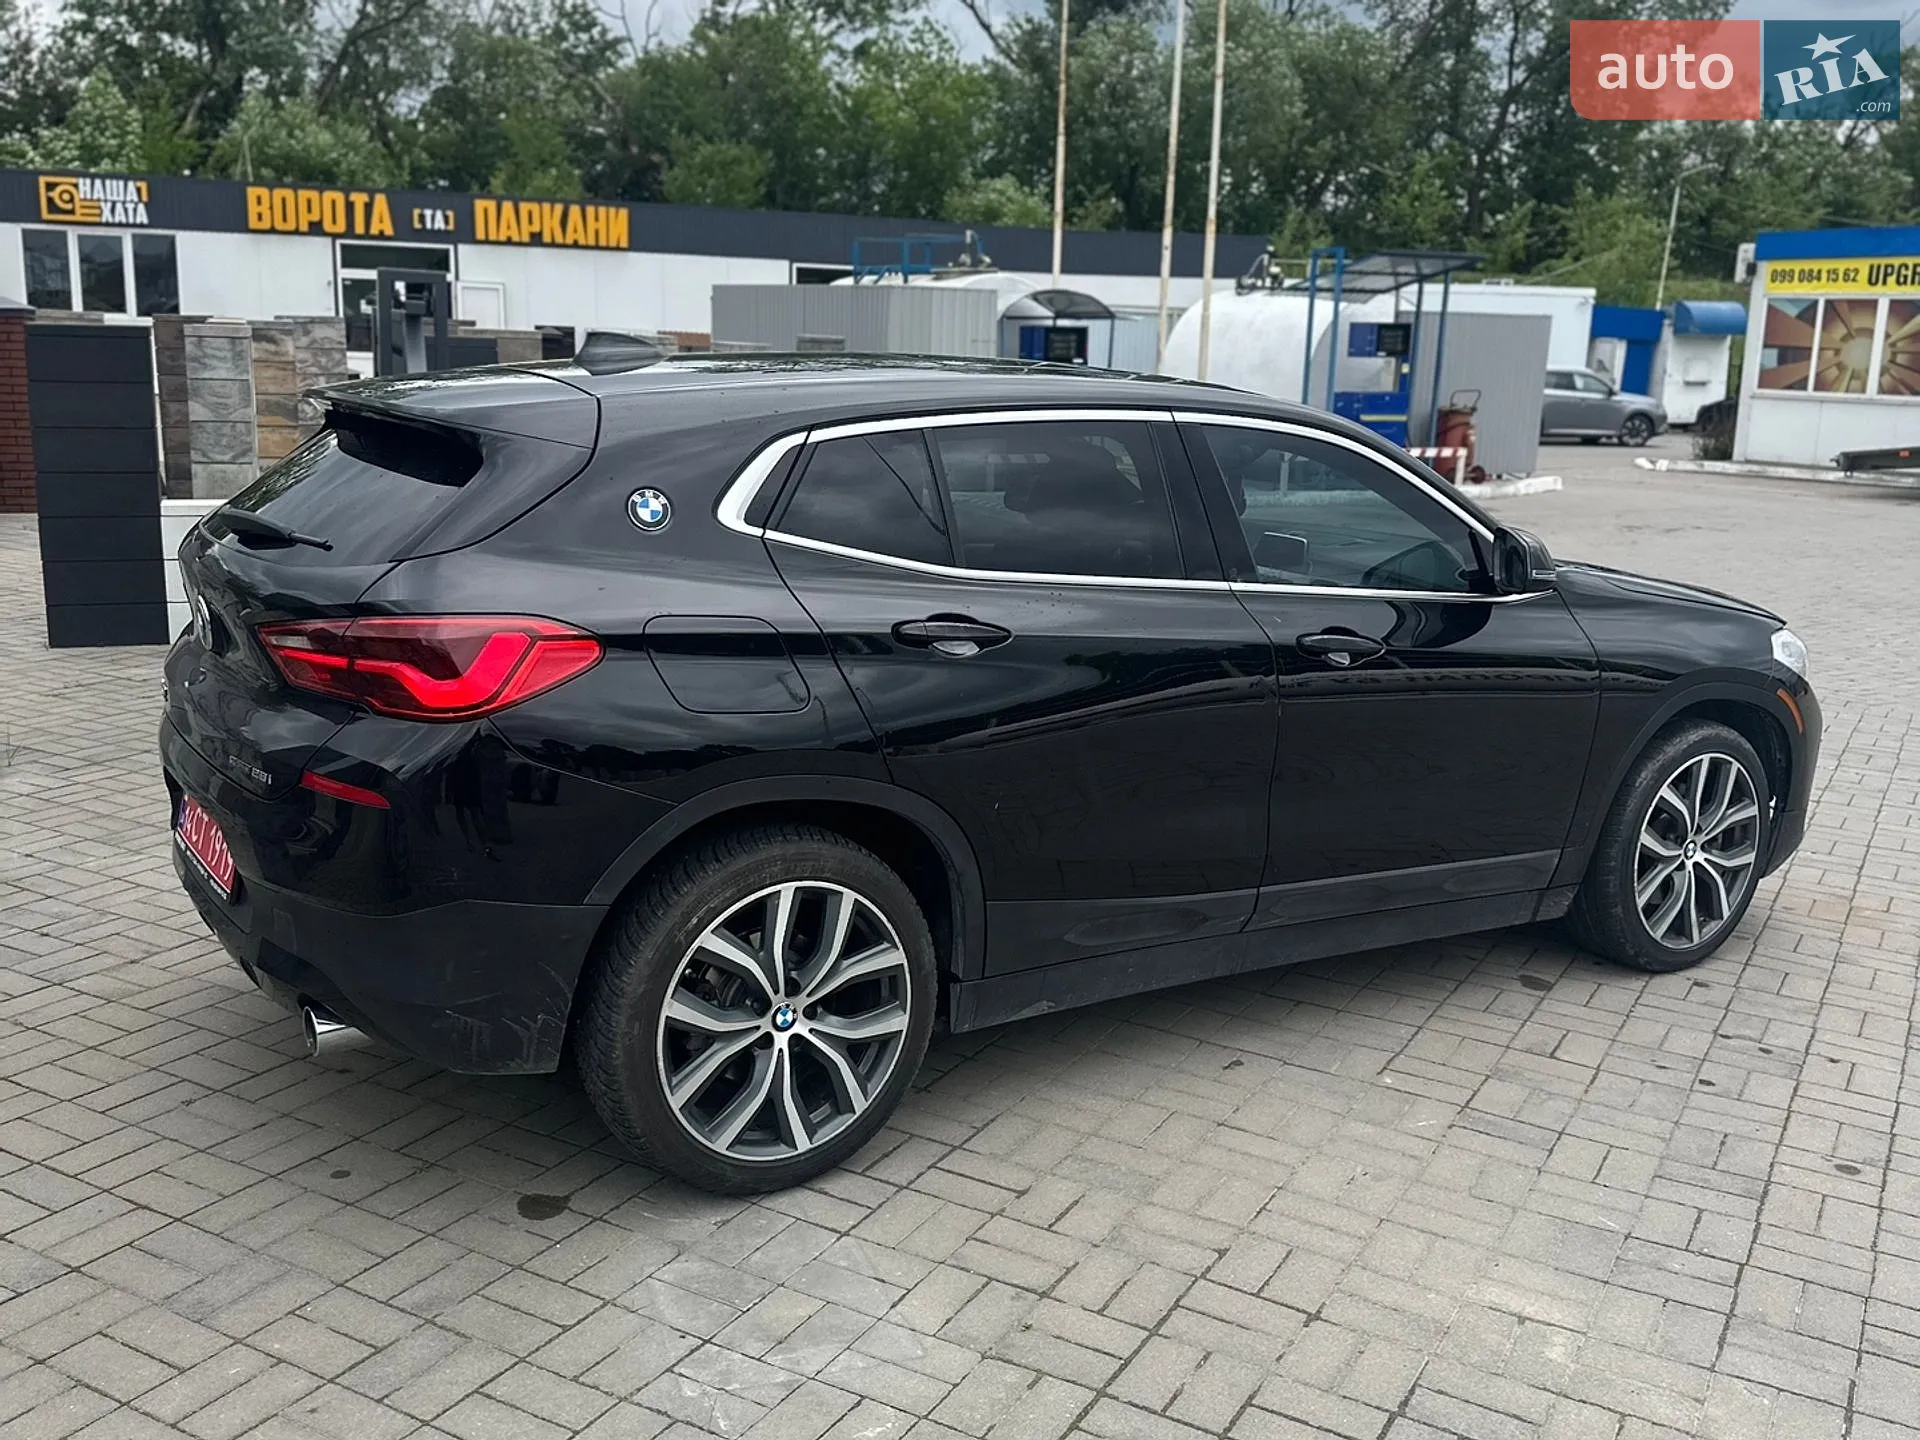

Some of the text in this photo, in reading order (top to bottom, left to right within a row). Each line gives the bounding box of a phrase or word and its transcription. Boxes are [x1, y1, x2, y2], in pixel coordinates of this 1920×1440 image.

[78, 177, 140, 202] НАША
[100, 201, 149, 225] ХАТА
[246, 186, 394, 237] ВОРОТА
[474, 198, 629, 249] ПАРКАНИ
[1770, 268, 1795, 284] 099
[1798, 268, 1822, 283] 084
[1826, 268, 1839, 283] 15
[1842, 267, 1860, 283] 62
